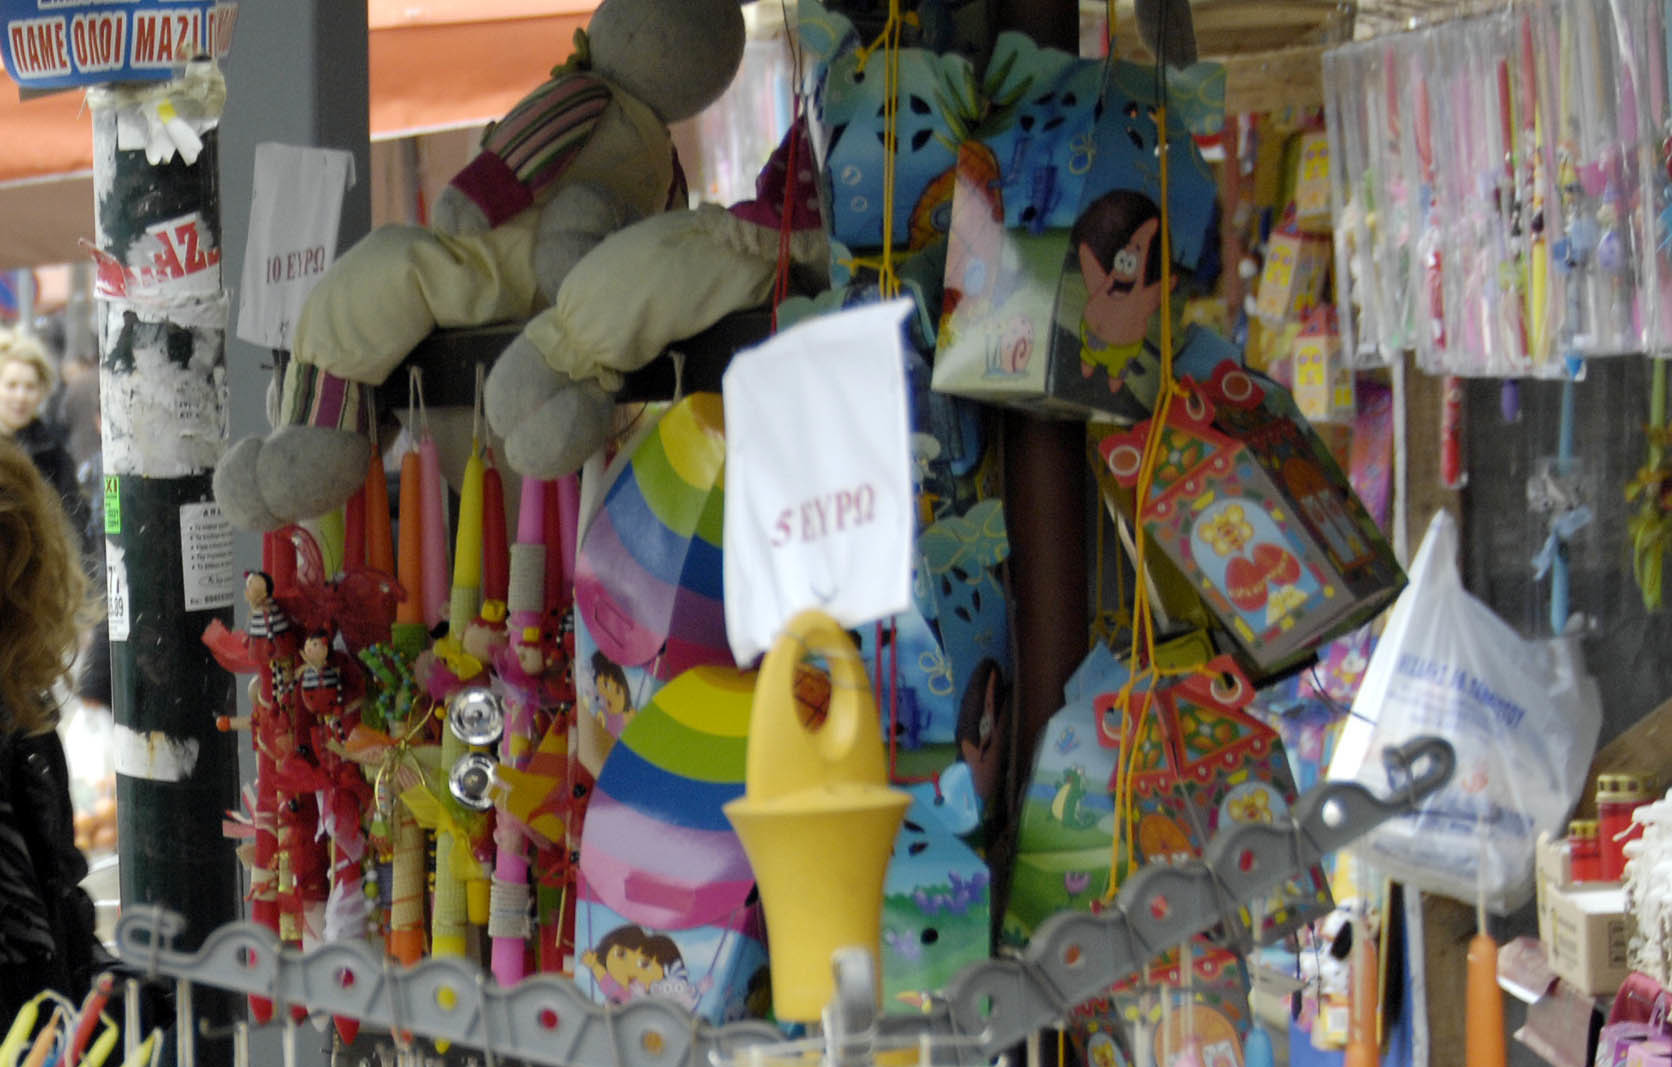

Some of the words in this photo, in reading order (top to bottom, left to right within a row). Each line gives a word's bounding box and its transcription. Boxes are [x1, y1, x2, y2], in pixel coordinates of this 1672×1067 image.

[10, 20, 69, 74] ΠΑΜΕ
[134, 11, 200, 63] ΜΑΖΙ
[266, 254, 281, 284] 10
[286, 245, 325, 280] ΕΥΡΩ
[770, 507, 794, 547] 5
[799, 482, 877, 544] ΕΥΡΩ
